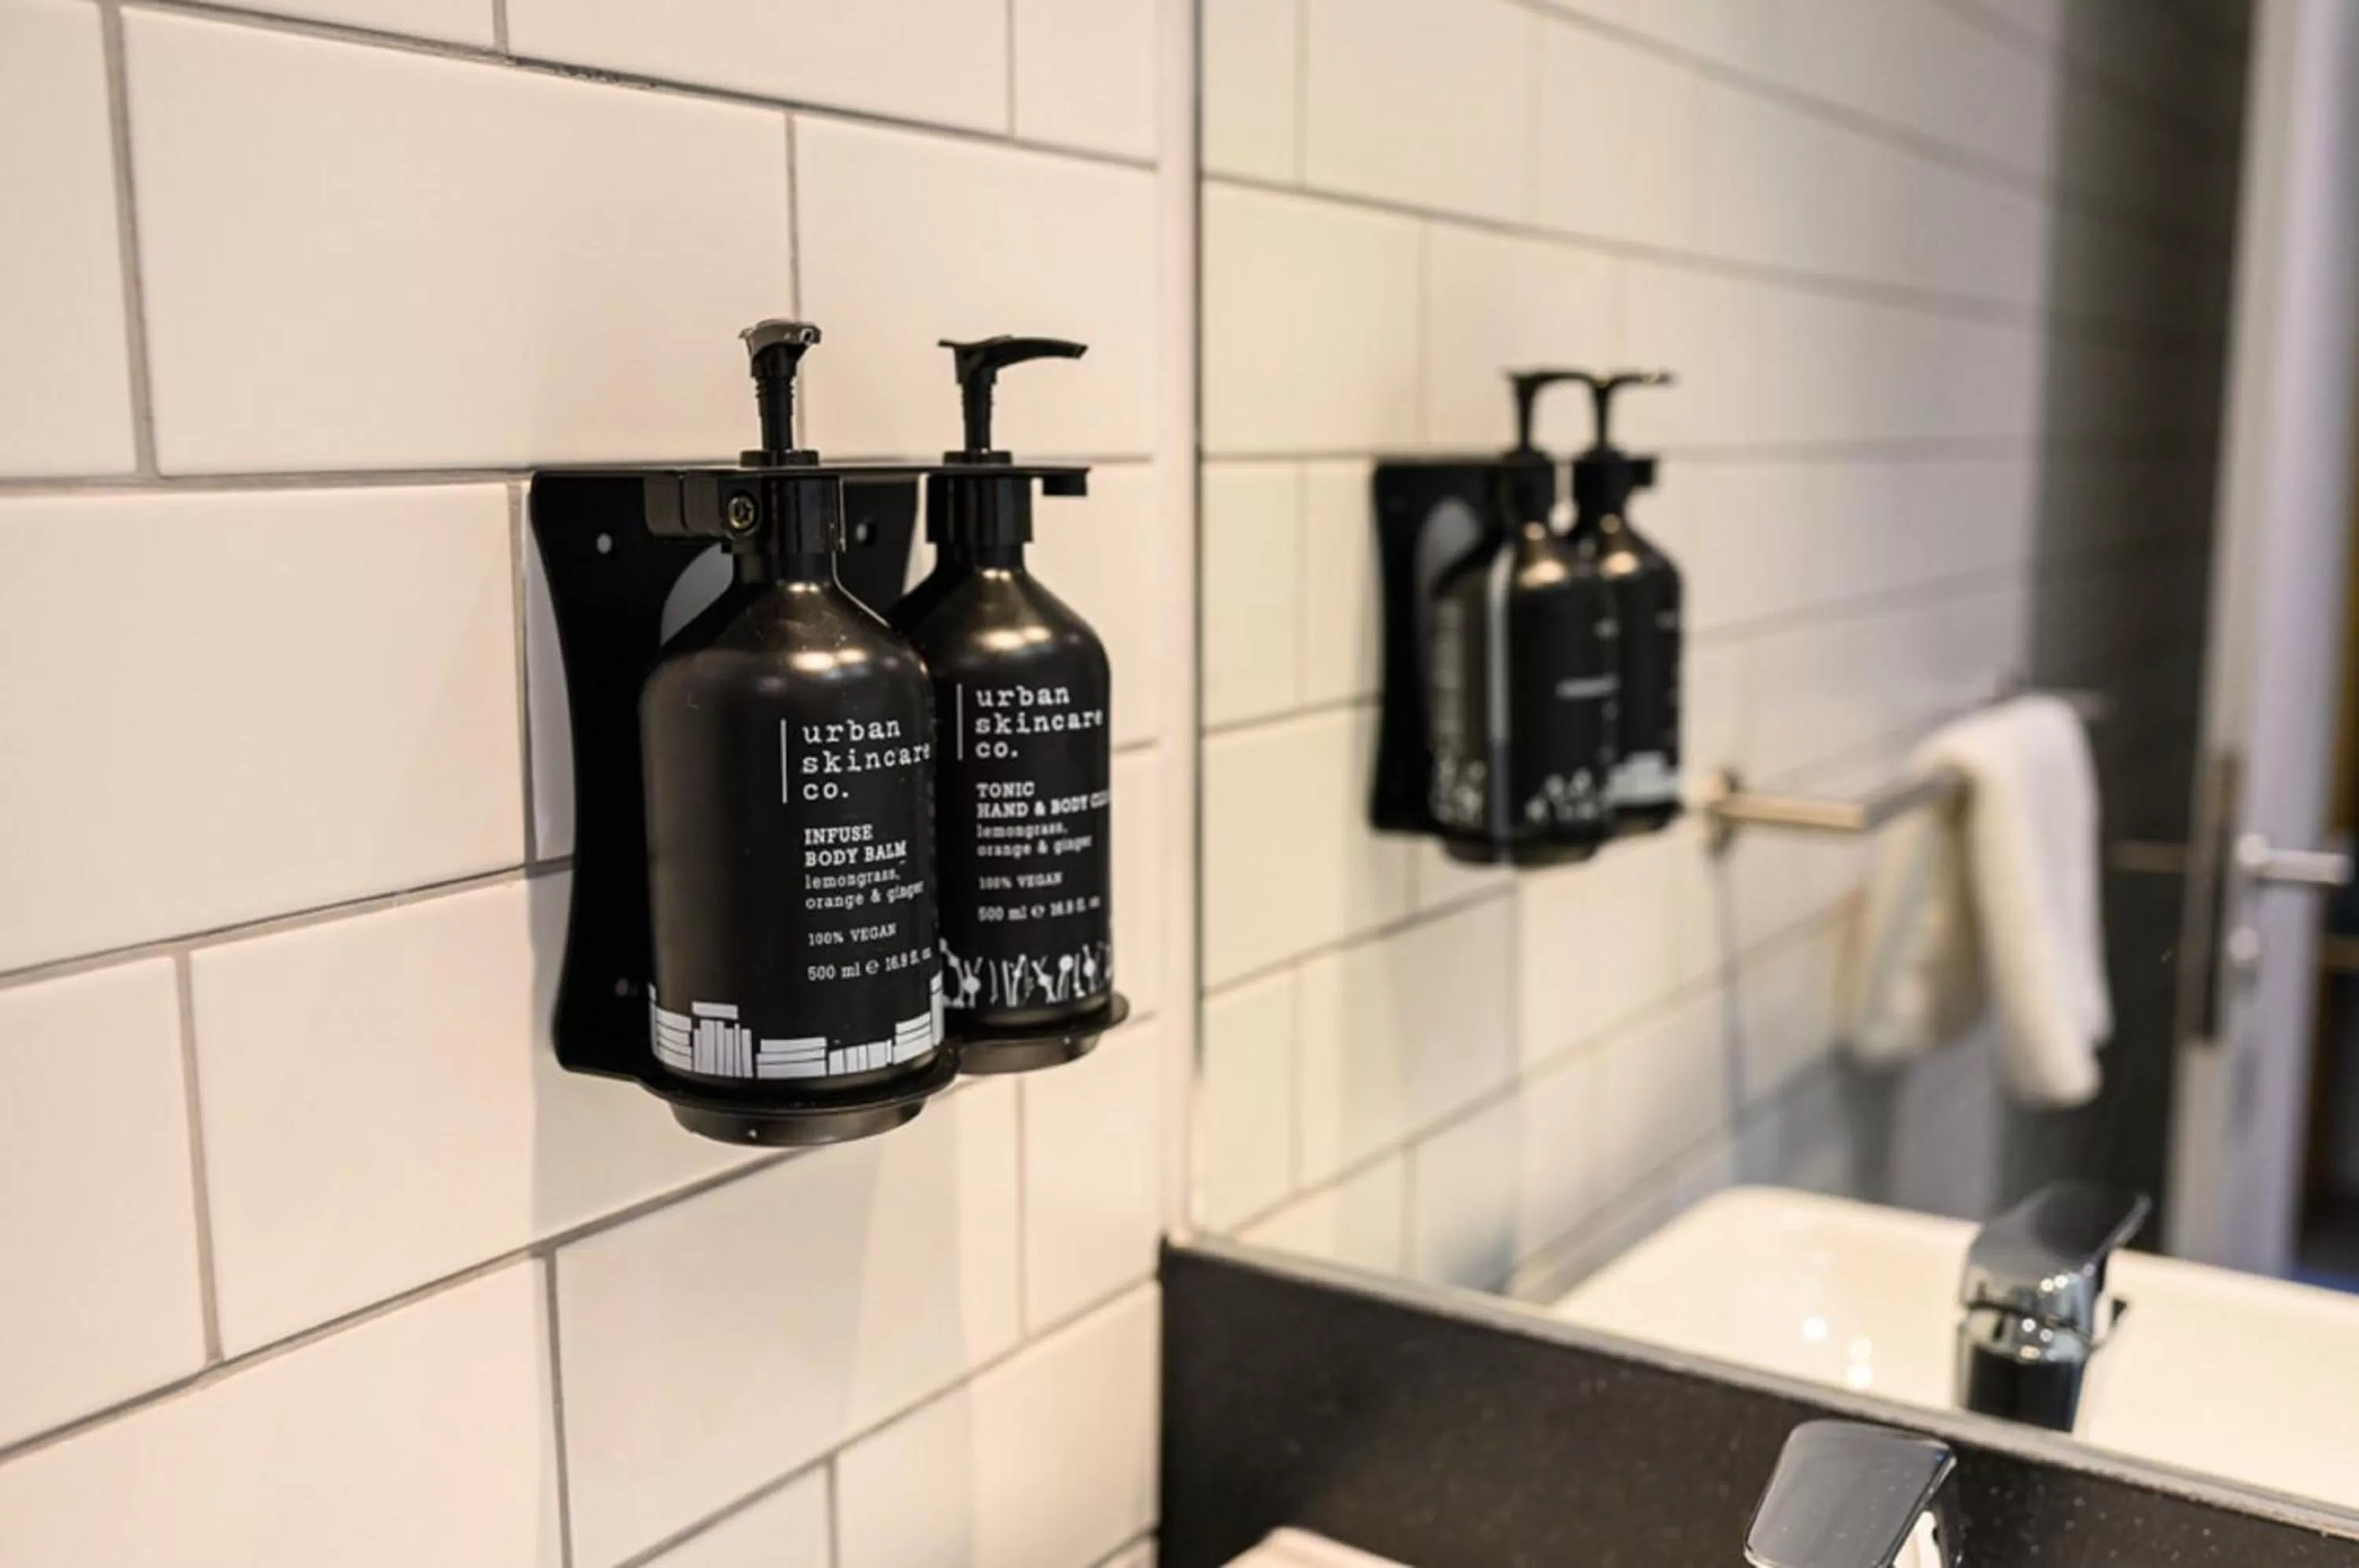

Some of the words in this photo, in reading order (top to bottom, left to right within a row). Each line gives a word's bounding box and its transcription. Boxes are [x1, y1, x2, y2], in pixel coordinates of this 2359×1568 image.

[975, 684, 1070, 708] urban
[802, 718, 901, 743] urban
[975, 709, 1102, 734] skincare
[974, 741, 1018, 759] co.
[802, 782, 849, 801] co.
[976, 781, 1035, 798] TONIC
[977, 801, 1029, 819] HAND
[1033, 800, 1046, 816] &
[1050, 794, 1088, 815] BODY
[804, 823, 874, 845] INFUSE
[804, 847, 858, 867] BODY
[864, 840, 907, 863] BALM
[977, 843, 1032, 859] orange
[1037, 839, 1047, 854] &
[978, 876, 1012, 890] 100%
[1016, 871, 1062, 888] VEGAN
[804, 893, 864, 910] orange
[870, 888, 881, 904] &
[977, 905, 1004, 922] 500
[1007, 905, 1027, 921] ml
[808, 931, 844, 946] 100%
[849, 922, 896, 942] VEGAN
[807, 965, 835, 981] 500
[841, 961, 860, 978] ml
